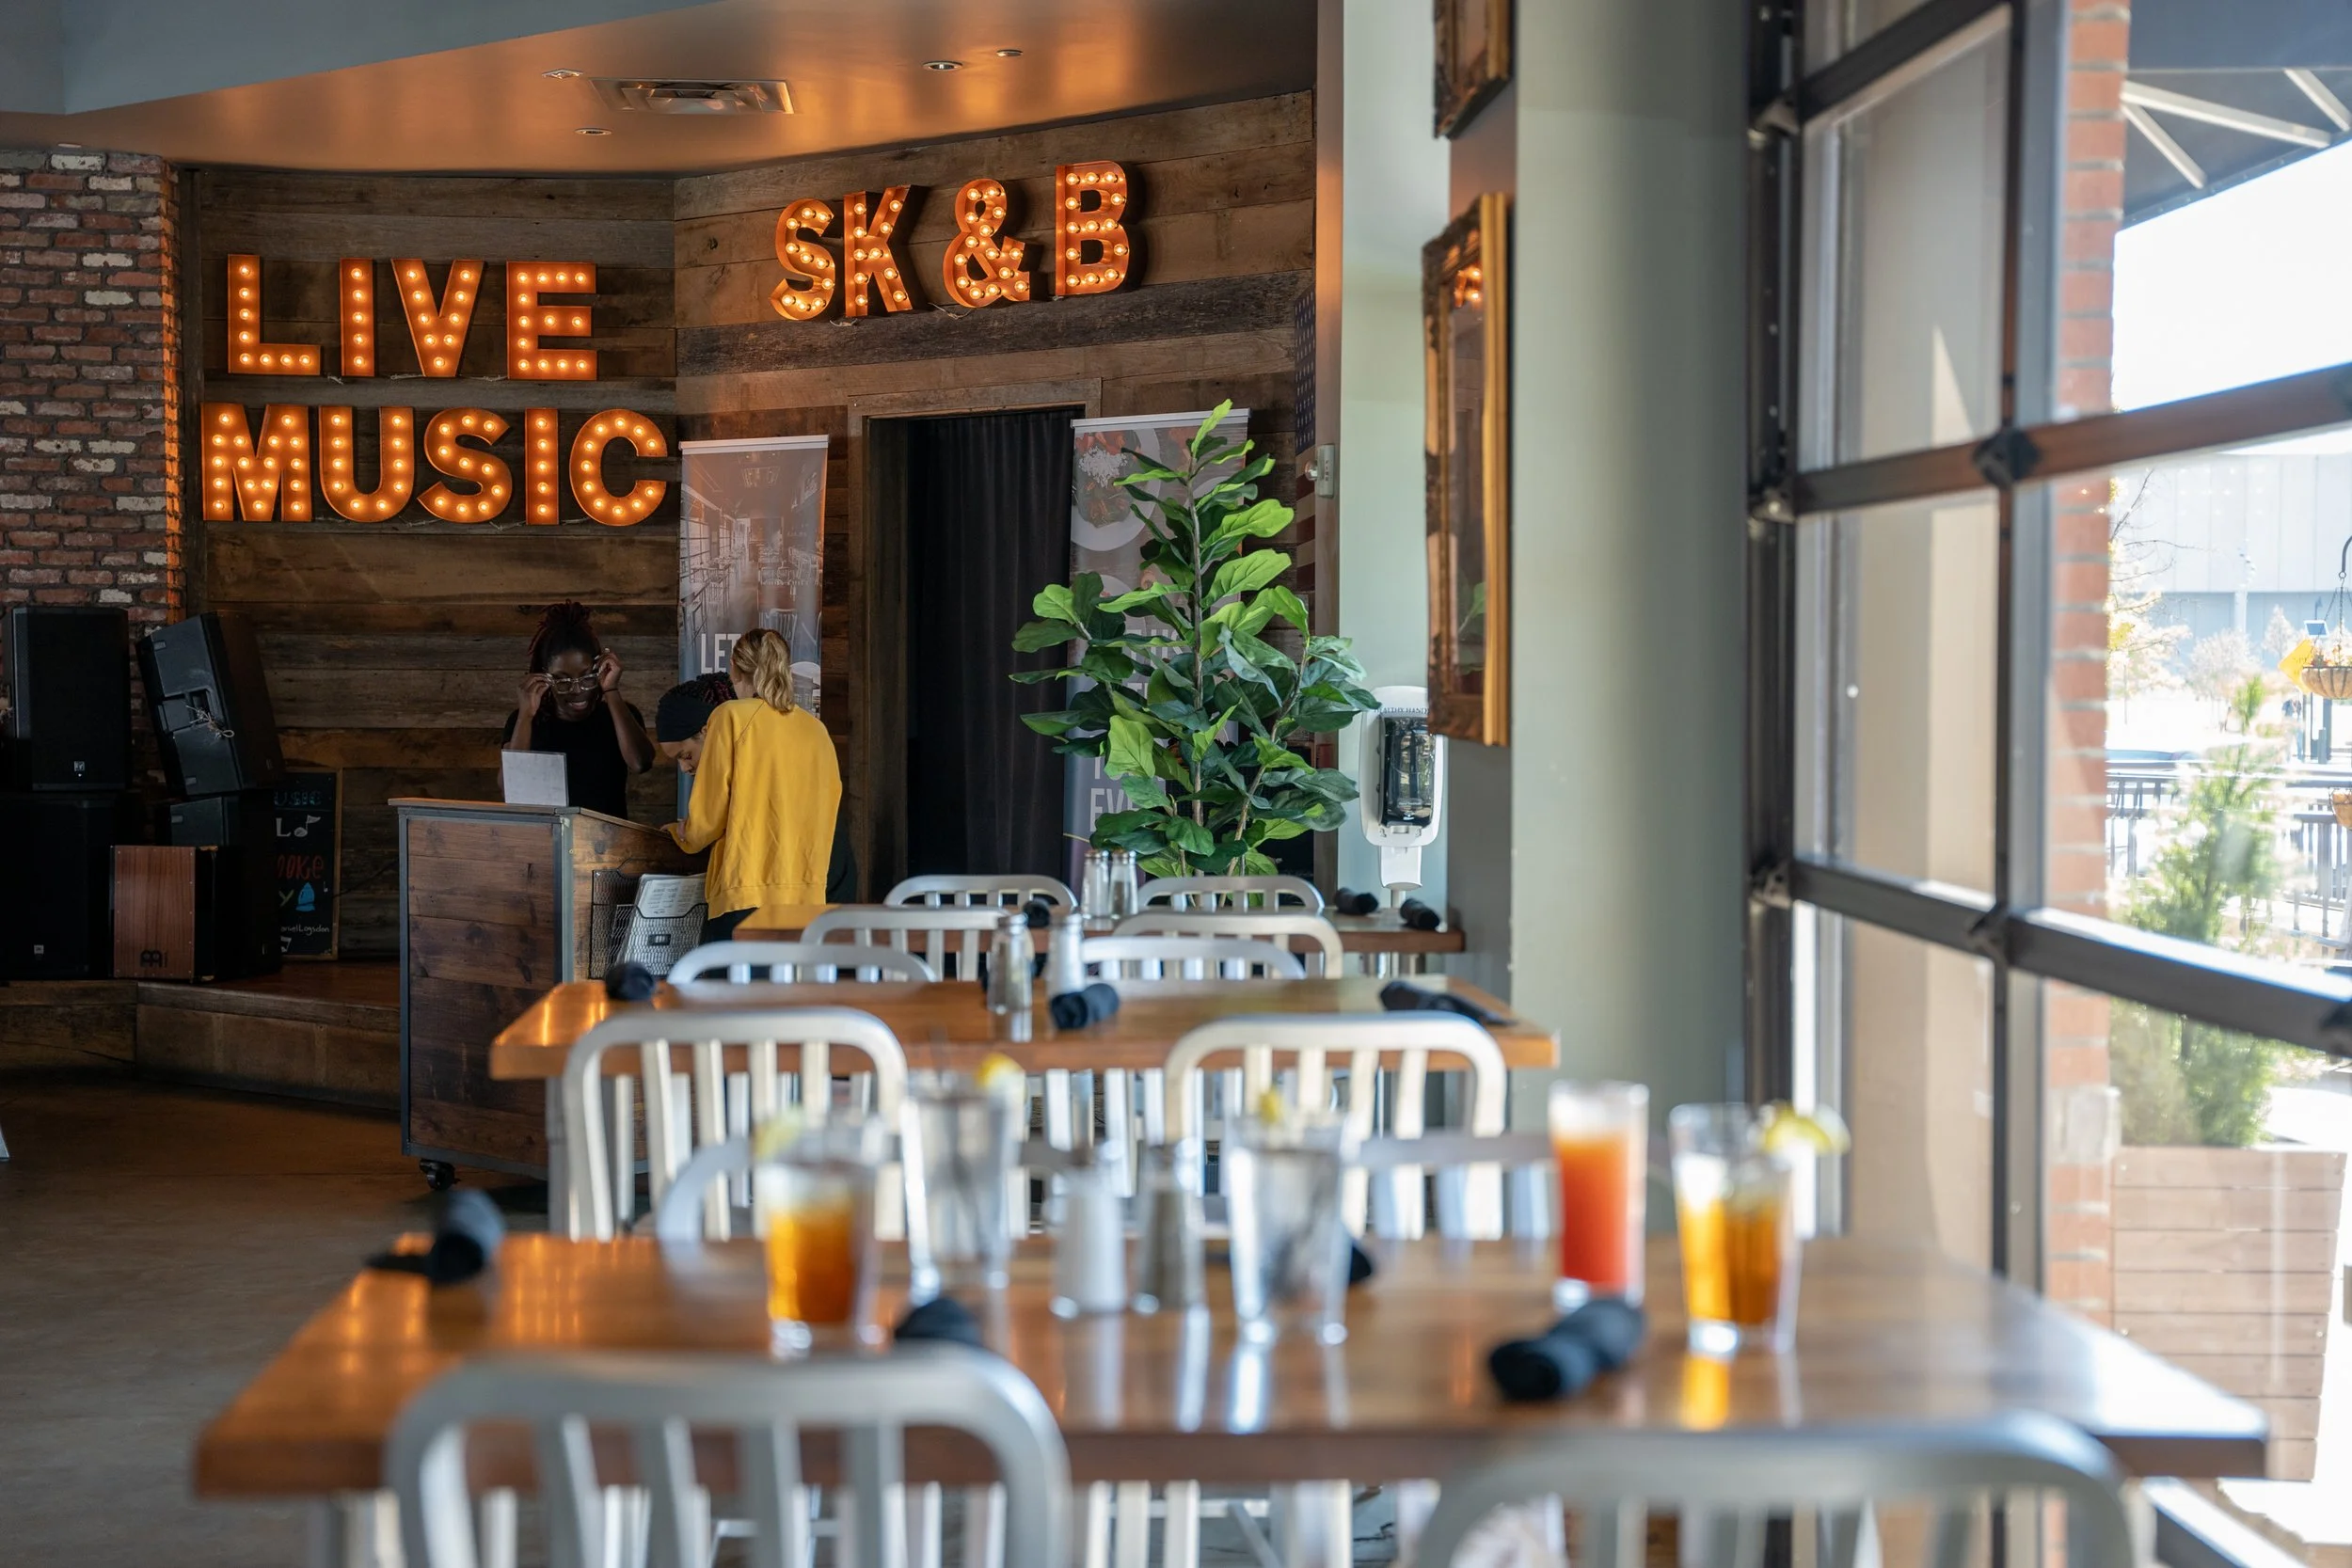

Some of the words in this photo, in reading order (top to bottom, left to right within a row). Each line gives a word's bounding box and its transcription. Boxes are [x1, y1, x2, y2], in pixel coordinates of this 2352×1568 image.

[771, 184, 914, 321] SK
[944, 178, 1031, 309] &
[1056, 160, 1129, 296] B
[227, 254, 598, 381] LIVE
[201, 403, 668, 527] MUSIC
